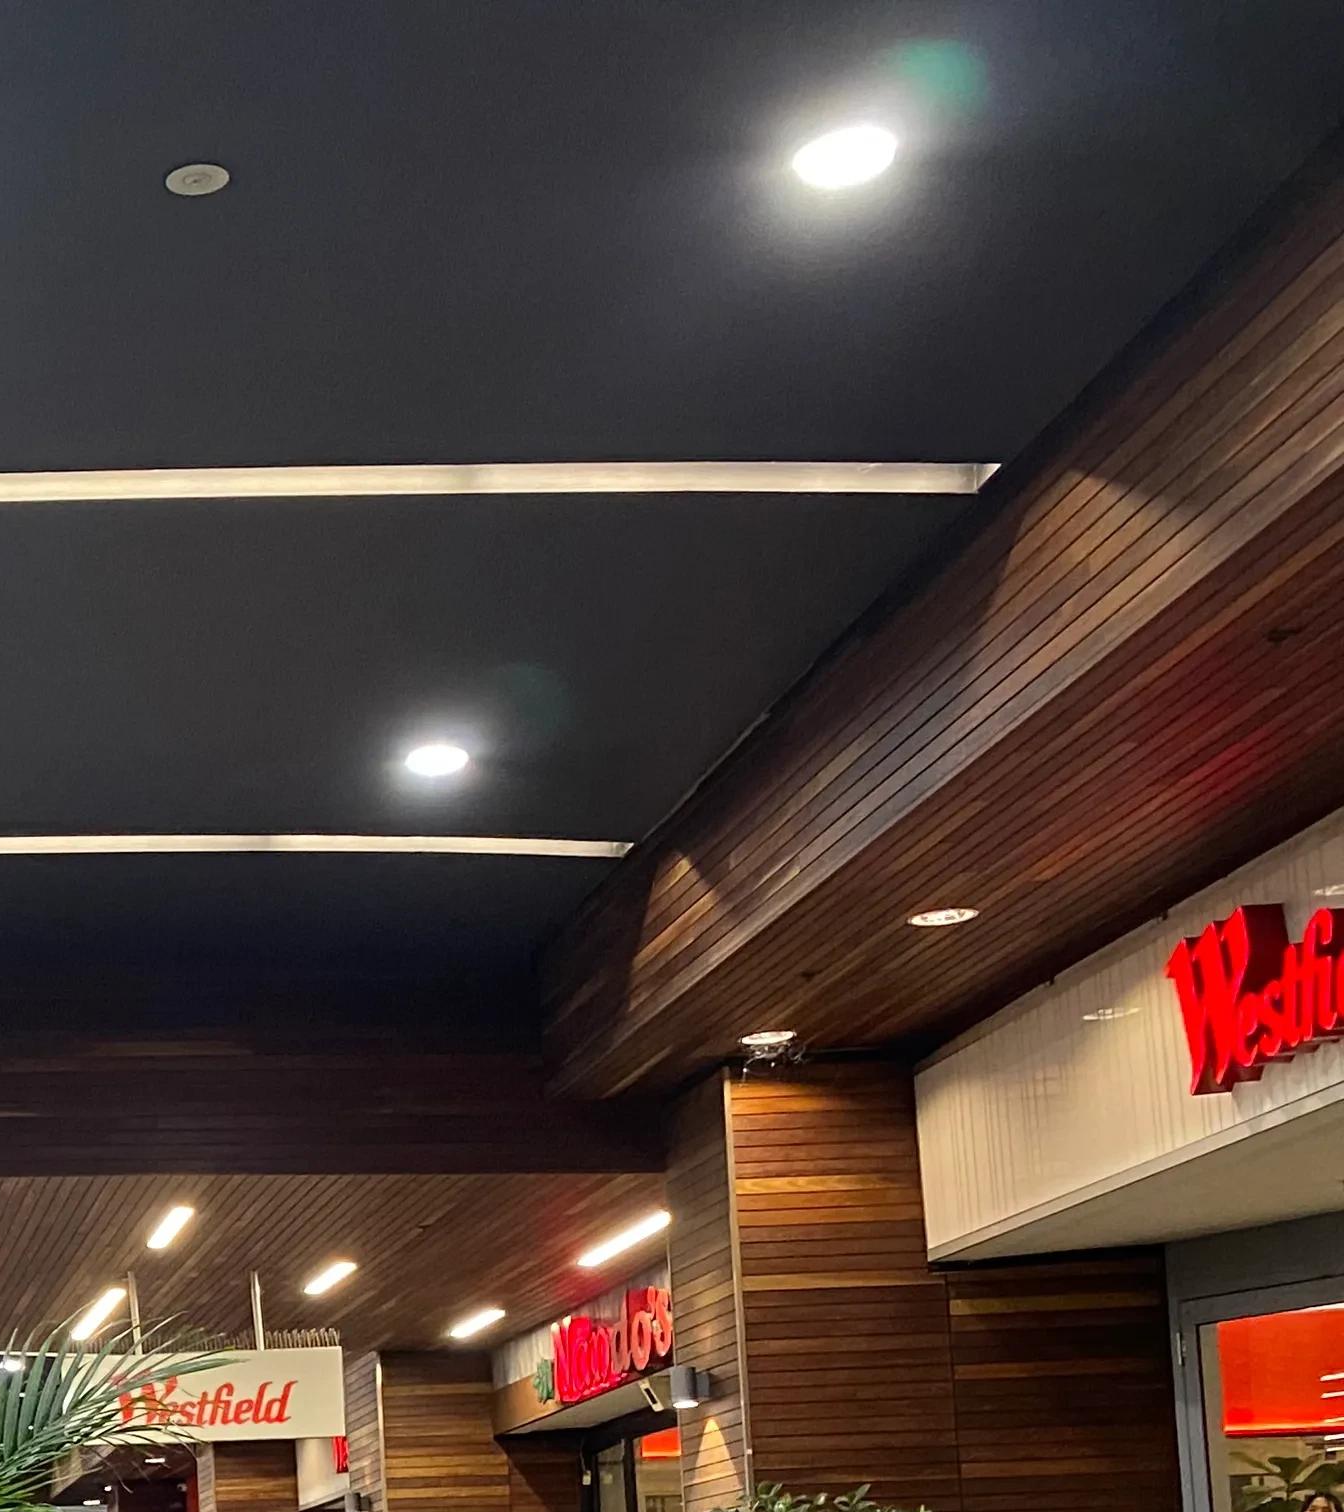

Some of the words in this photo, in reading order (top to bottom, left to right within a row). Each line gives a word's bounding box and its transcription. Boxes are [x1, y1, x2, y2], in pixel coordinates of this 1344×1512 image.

[1165, 905, 1344, 1096] Westfi
[111, 1369, 298, 1428] Westfield
[551, 1285, 673, 1403] Nando's
